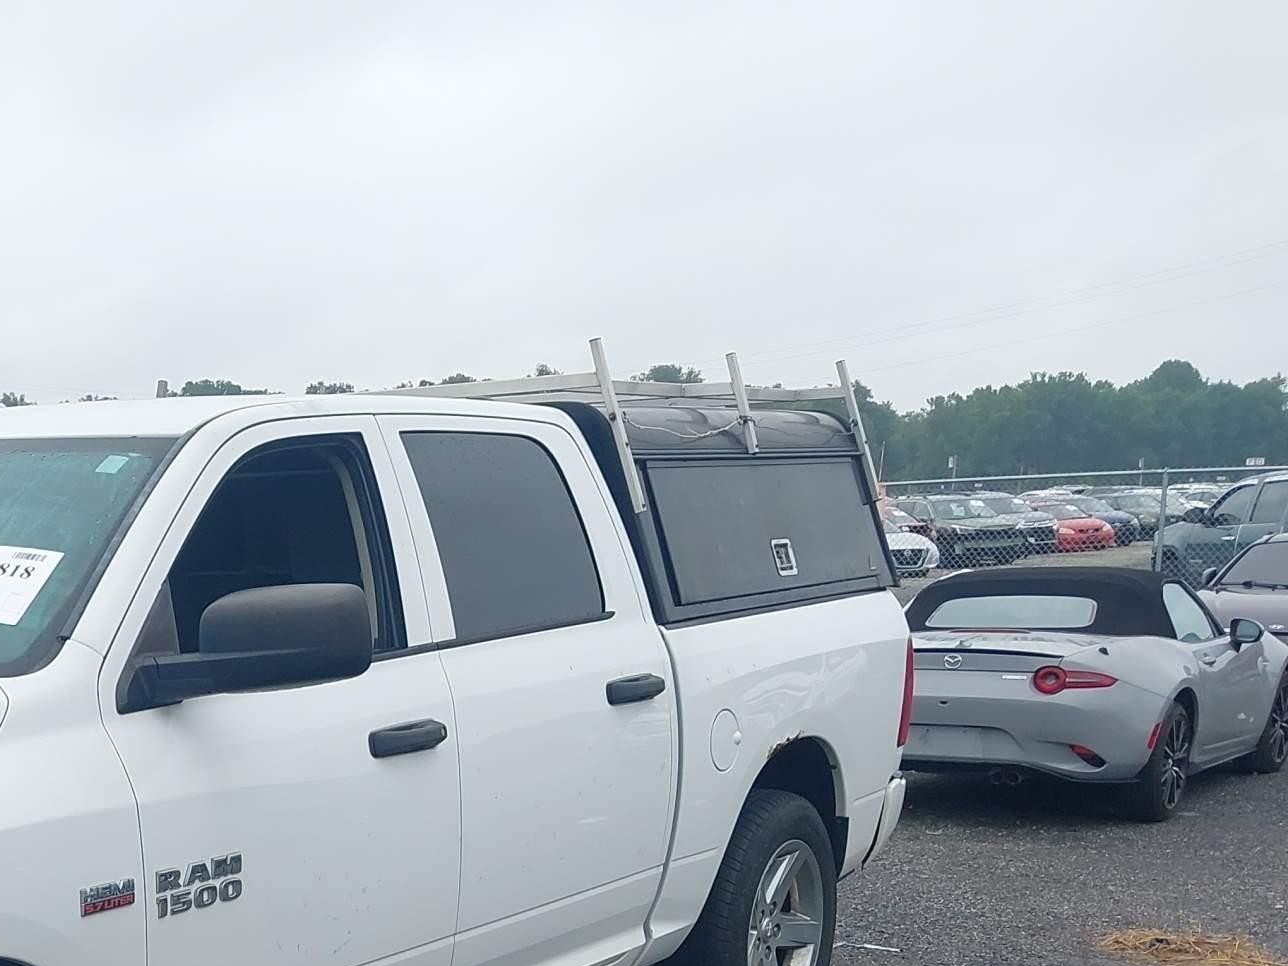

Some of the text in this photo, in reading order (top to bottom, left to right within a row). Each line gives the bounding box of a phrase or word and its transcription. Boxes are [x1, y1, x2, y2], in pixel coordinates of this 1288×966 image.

[155, 851, 242, 894] RAM
[80, 879, 135, 902] HEMI
[84, 895, 134, 914] 5.7 LITER
[156, 877, 242, 919] 1500
